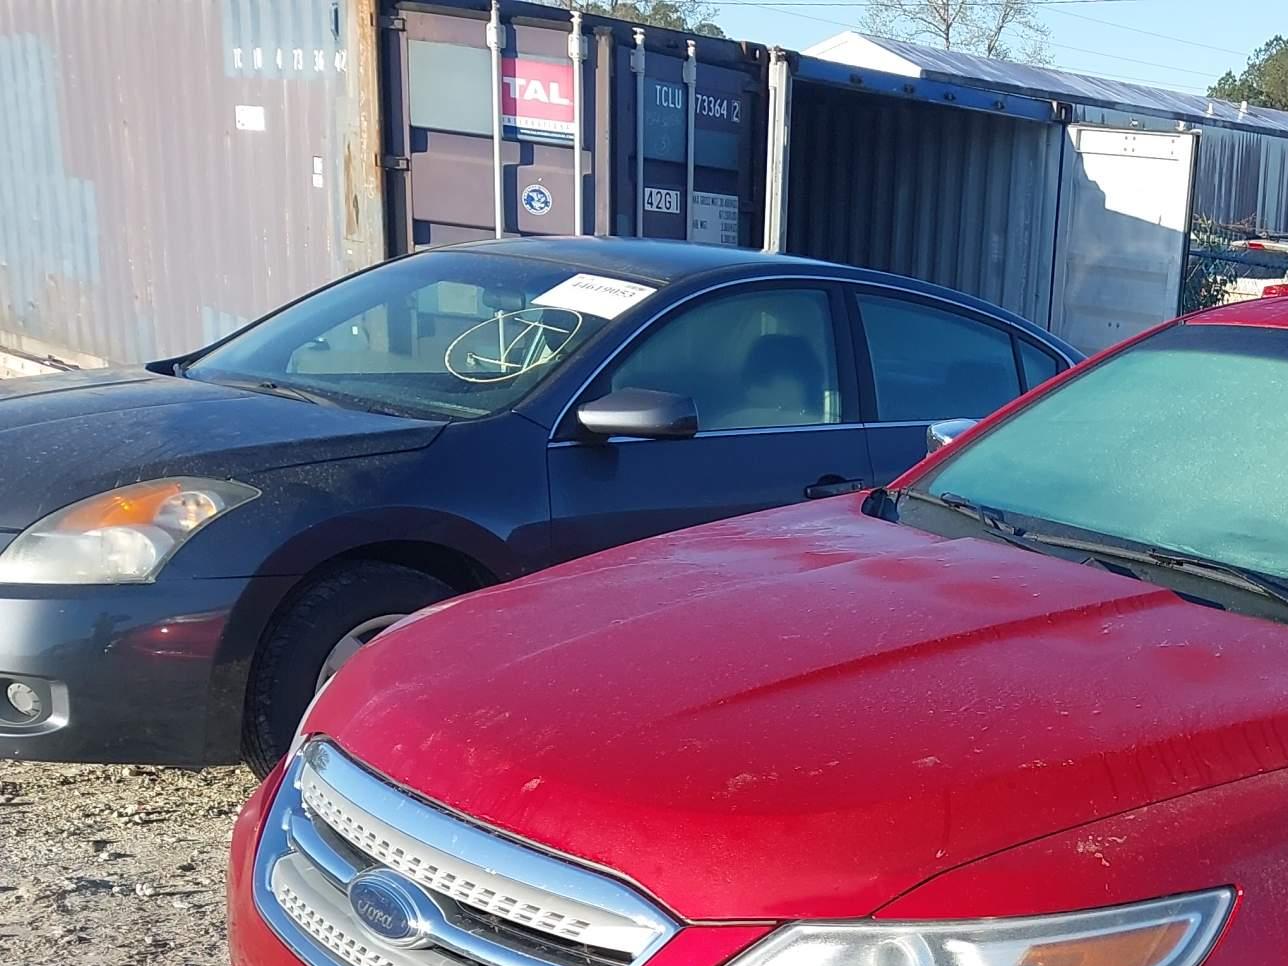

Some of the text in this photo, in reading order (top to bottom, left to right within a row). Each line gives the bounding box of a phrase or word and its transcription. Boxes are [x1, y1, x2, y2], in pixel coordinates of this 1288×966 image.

[503, 77, 570, 106] TAL
[656, 85, 740, 121] TCLU 73364 2
[646, 190, 679, 212] 42G1
